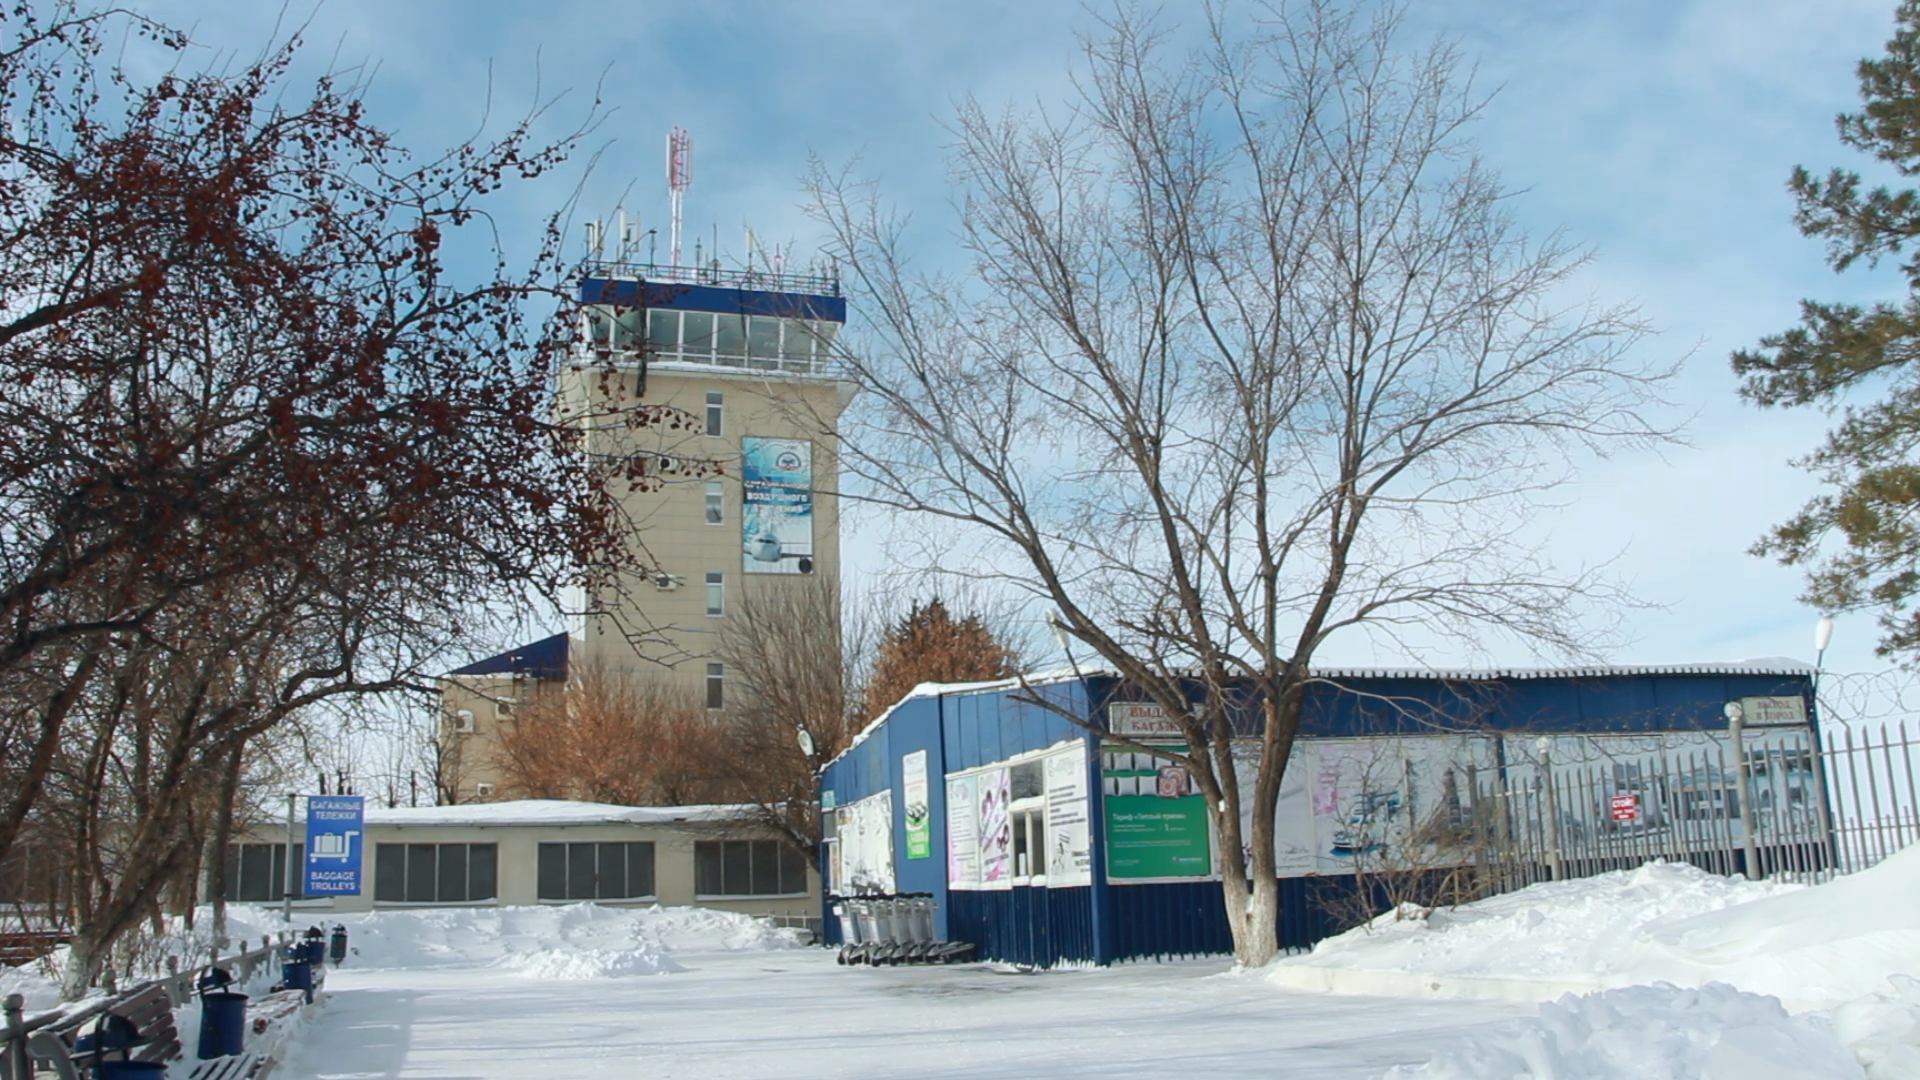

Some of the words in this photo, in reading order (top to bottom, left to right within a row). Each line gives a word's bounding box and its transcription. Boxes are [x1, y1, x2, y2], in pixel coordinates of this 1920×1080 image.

[310, 800, 361, 810] БАГАЖНЫЕ
[315, 811, 357, 820] ТЕЛЕЖКИ
[311, 871, 355, 880] BAGGAGE
[310, 881, 355, 890] TROLLEYS
